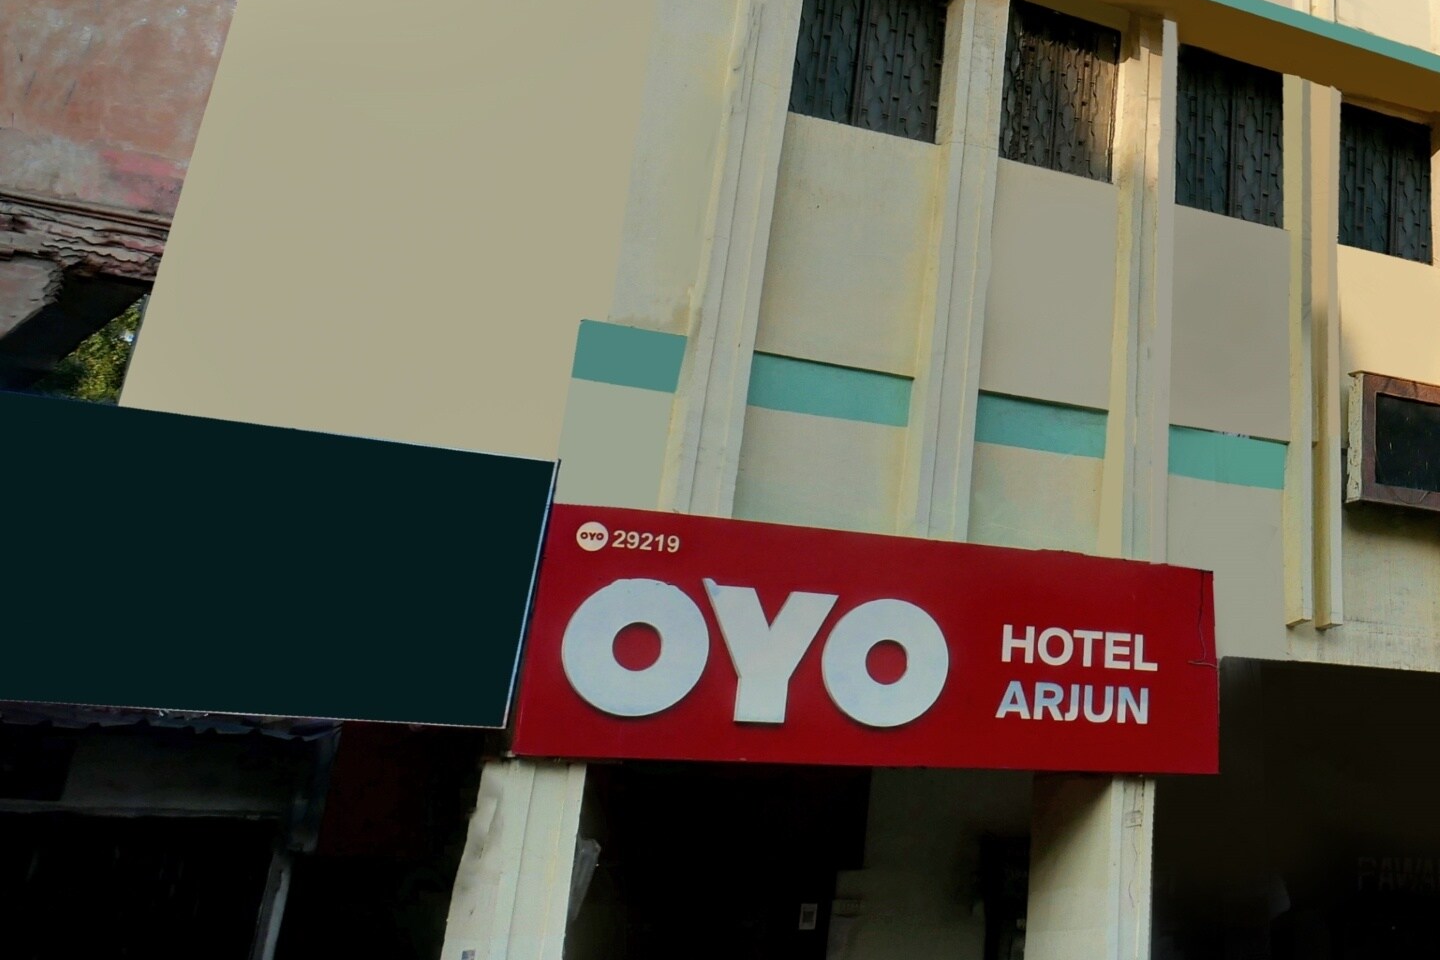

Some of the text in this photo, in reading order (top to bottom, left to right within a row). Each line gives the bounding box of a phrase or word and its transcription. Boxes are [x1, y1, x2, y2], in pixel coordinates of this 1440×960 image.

[580, 529, 680, 553] OYO 29219
[561, 577, 950, 728] OYO
[1001, 623, 1159, 672] HOTEL
[995, 680, 1150, 725] ARJUN
